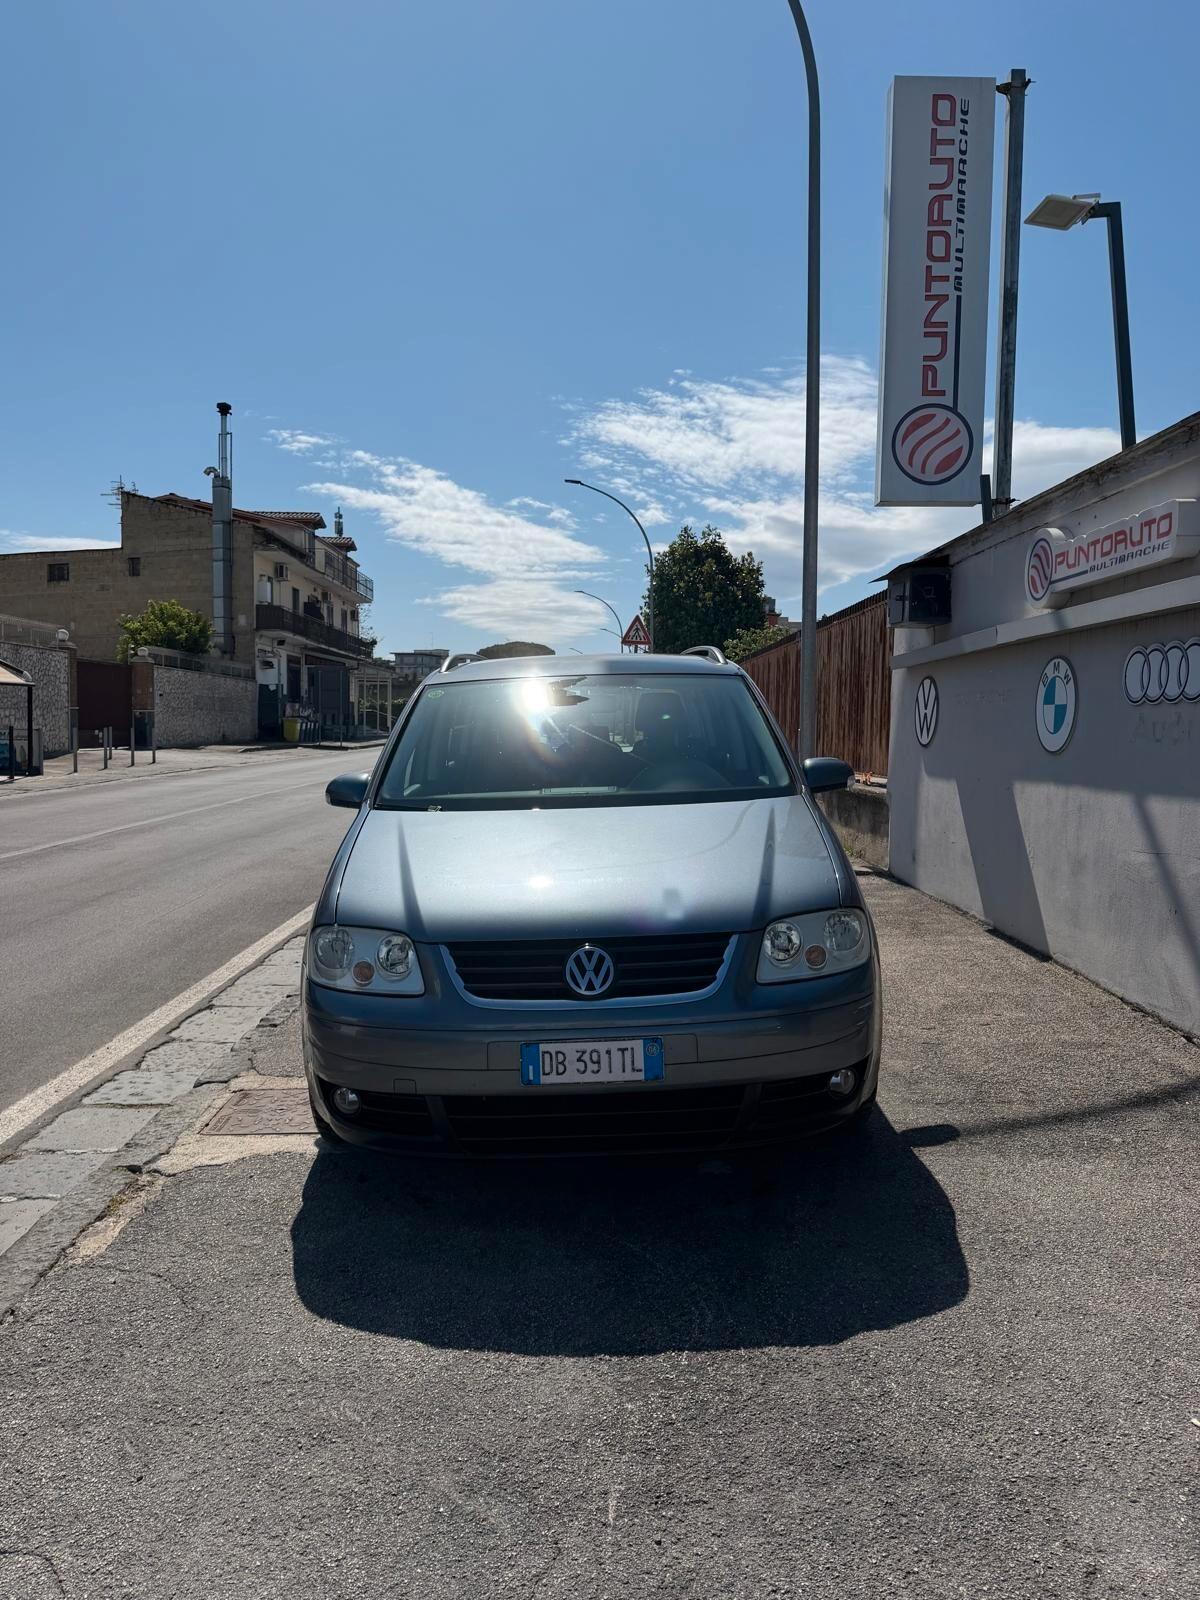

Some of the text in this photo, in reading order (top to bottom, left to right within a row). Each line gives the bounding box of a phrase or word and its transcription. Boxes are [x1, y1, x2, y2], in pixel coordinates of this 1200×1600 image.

[953, 97, 970, 293] MULTIMARCHE
[922, 93, 957, 397] PUNTOAUTO
[1054, 511, 1173, 575] PUNTOAUTO
[1089, 539, 1171, 574] MULTIMARCHE
[1041, 661, 1072, 687] BMW
[541, 1046, 643, 1076] DB 391TL
